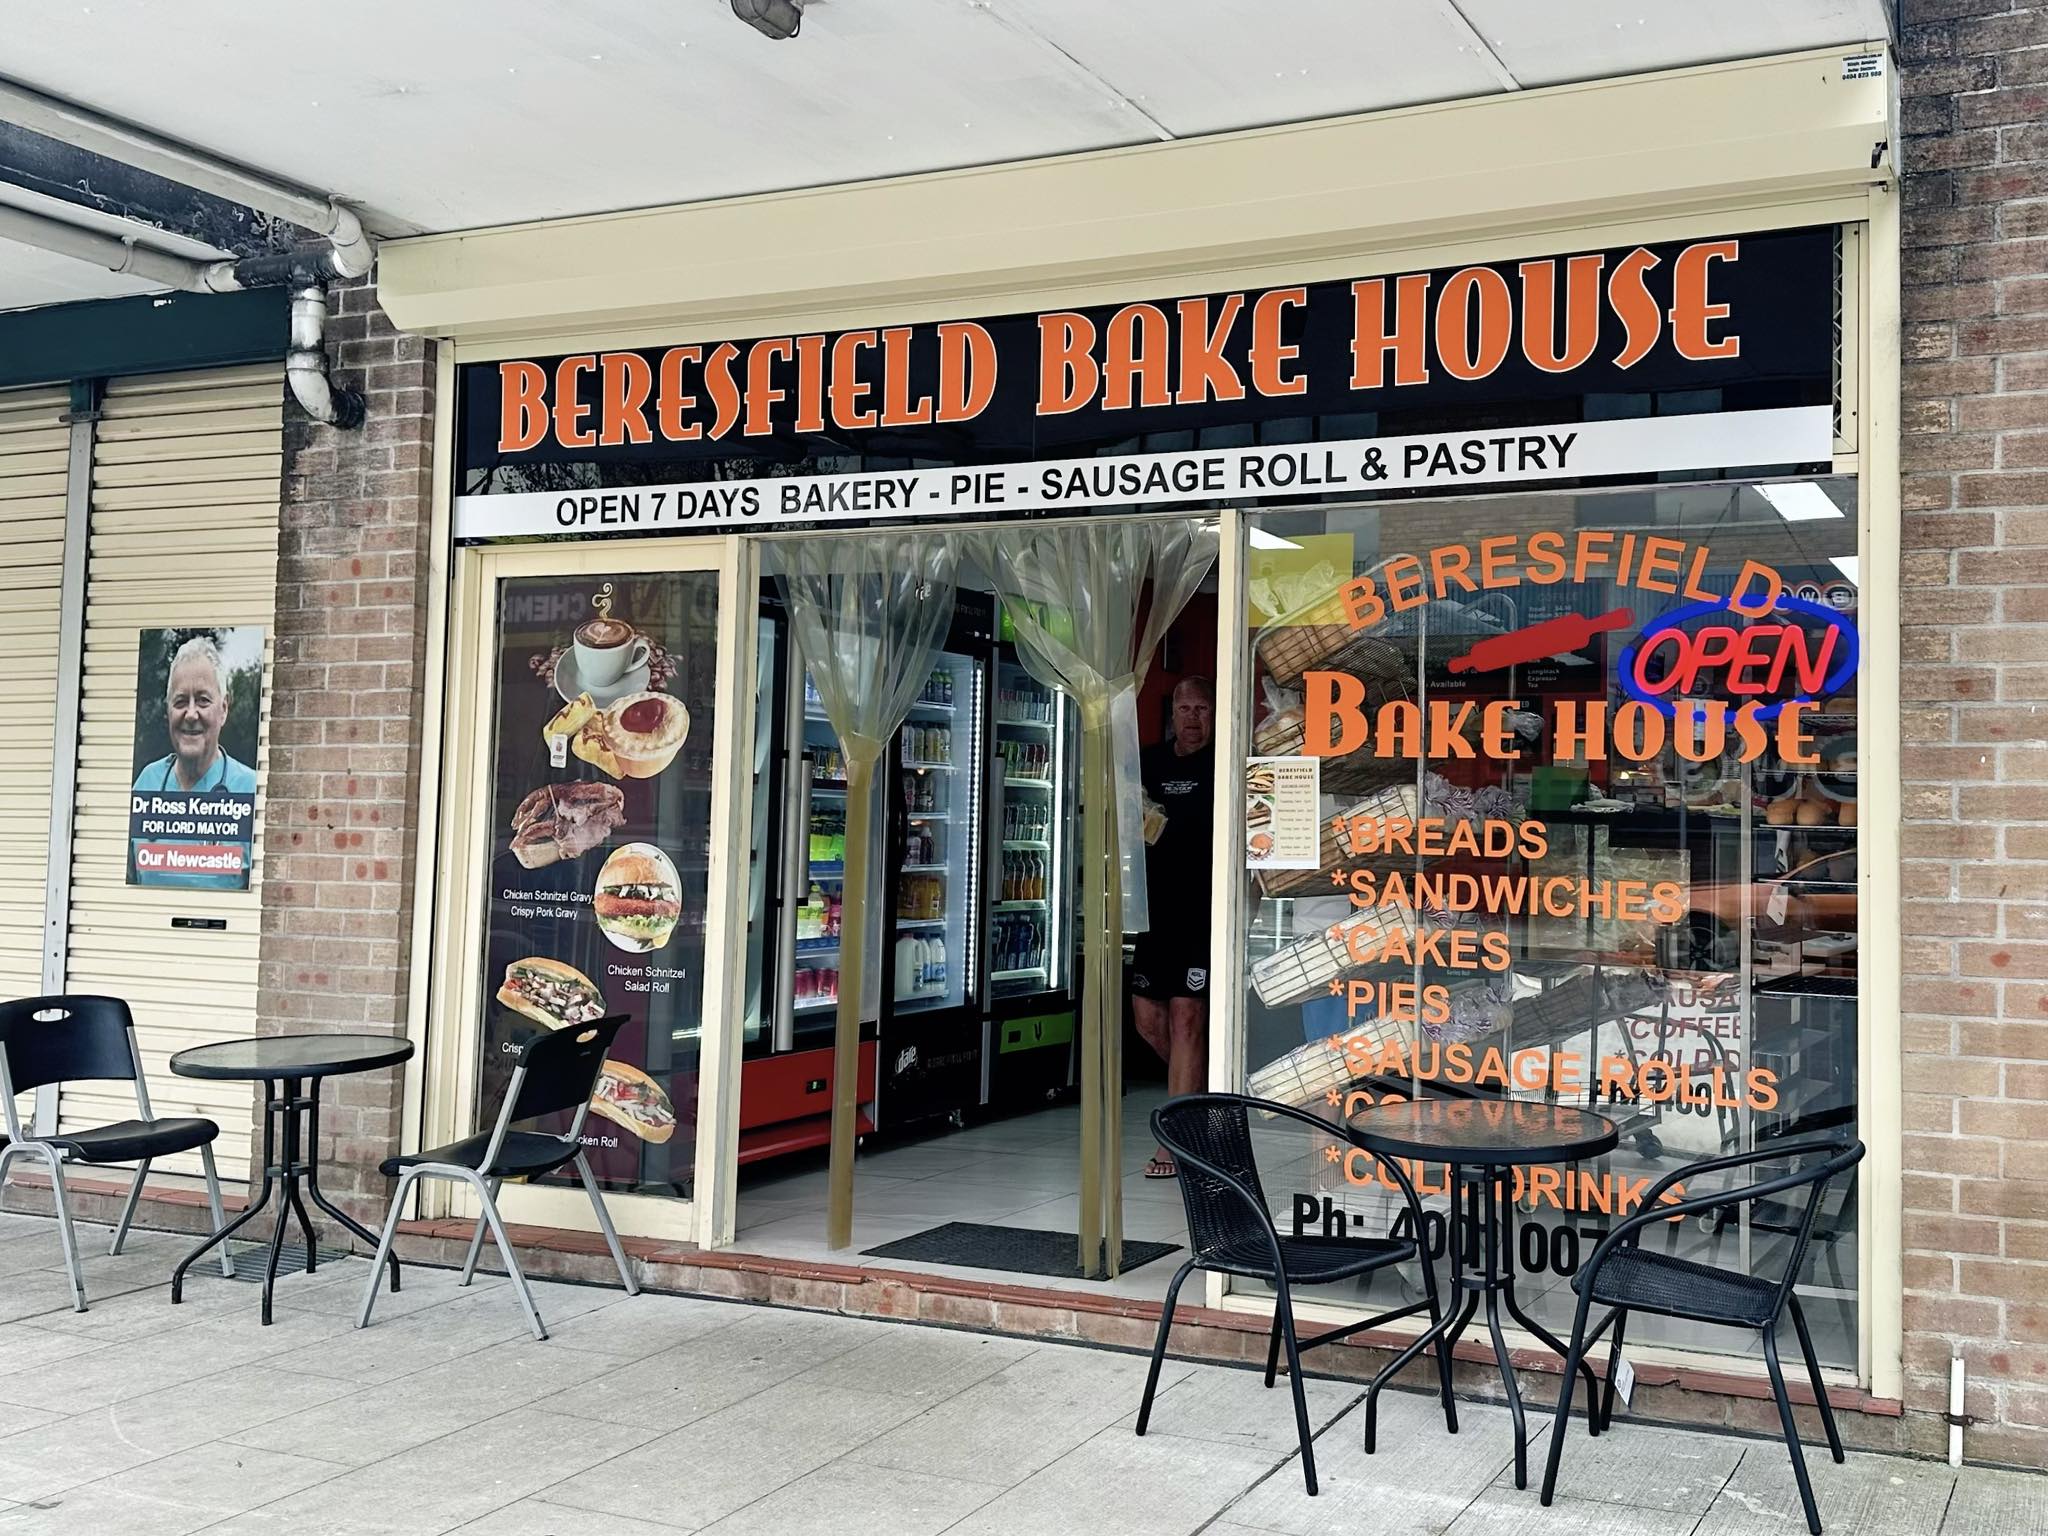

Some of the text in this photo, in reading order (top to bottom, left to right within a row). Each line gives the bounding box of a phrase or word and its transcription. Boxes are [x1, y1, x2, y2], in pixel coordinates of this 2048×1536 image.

[497, 240, 1741, 453] BERESFIELD BAKE HOUSE
[556, 494, 640, 527] OPEN
[651, 493, 667, 521] 7
[677, 486, 760, 520] DAYS
[780, 477, 919, 514] BAKERY
[951, 471, 1005, 505] PIE
[1041, 457, 1225, 499] SAUSAGE
[1239, 450, 1347, 489] ROLL
[1360, 447, 1389, 481] &
[1403, 432, 1578, 479] PASTRY
[1340, 531, 1783, 631] BERESFIELD
[1634, 624, 1839, 695] OPEN
[1302, 670, 1820, 764] BAKE HOUSE
[132, 796, 251, 820] Dr Ross Kerridge
[142, 821, 239, 835] FOR LORD MAYOR
[138, 849, 242, 869] Our Newcastle
[503, 889, 593, 903] Chicken Schnitzel Gravy
[511, 906, 579, 920] Crispy Pork Gravy
[607, 964, 686, 979] Chicken Schnitzel
[624, 981, 670, 993] Salad Roll
[1601, 1054, 1778, 1111] ROLLS
[601, 1136, 618, 1147] Roll
